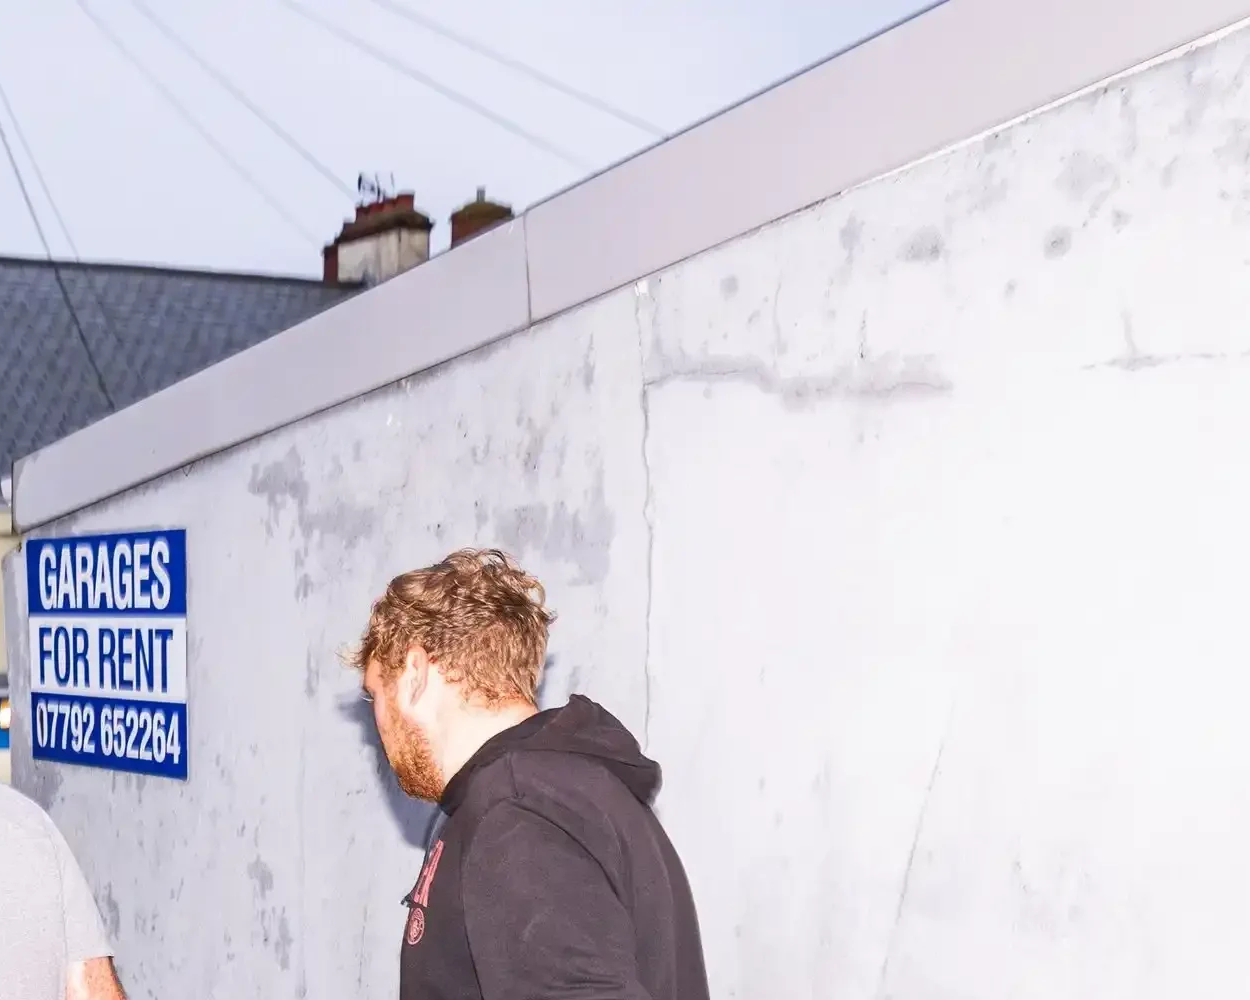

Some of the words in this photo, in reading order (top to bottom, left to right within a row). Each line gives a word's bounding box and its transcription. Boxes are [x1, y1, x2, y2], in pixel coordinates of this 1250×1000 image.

[38, 536, 171, 610] GARAGES
[38, 626, 90, 689] FOR
[98, 627, 173, 693] RENT
[36, 698, 95, 754] 07792
[100, 703, 181, 764] 652264
